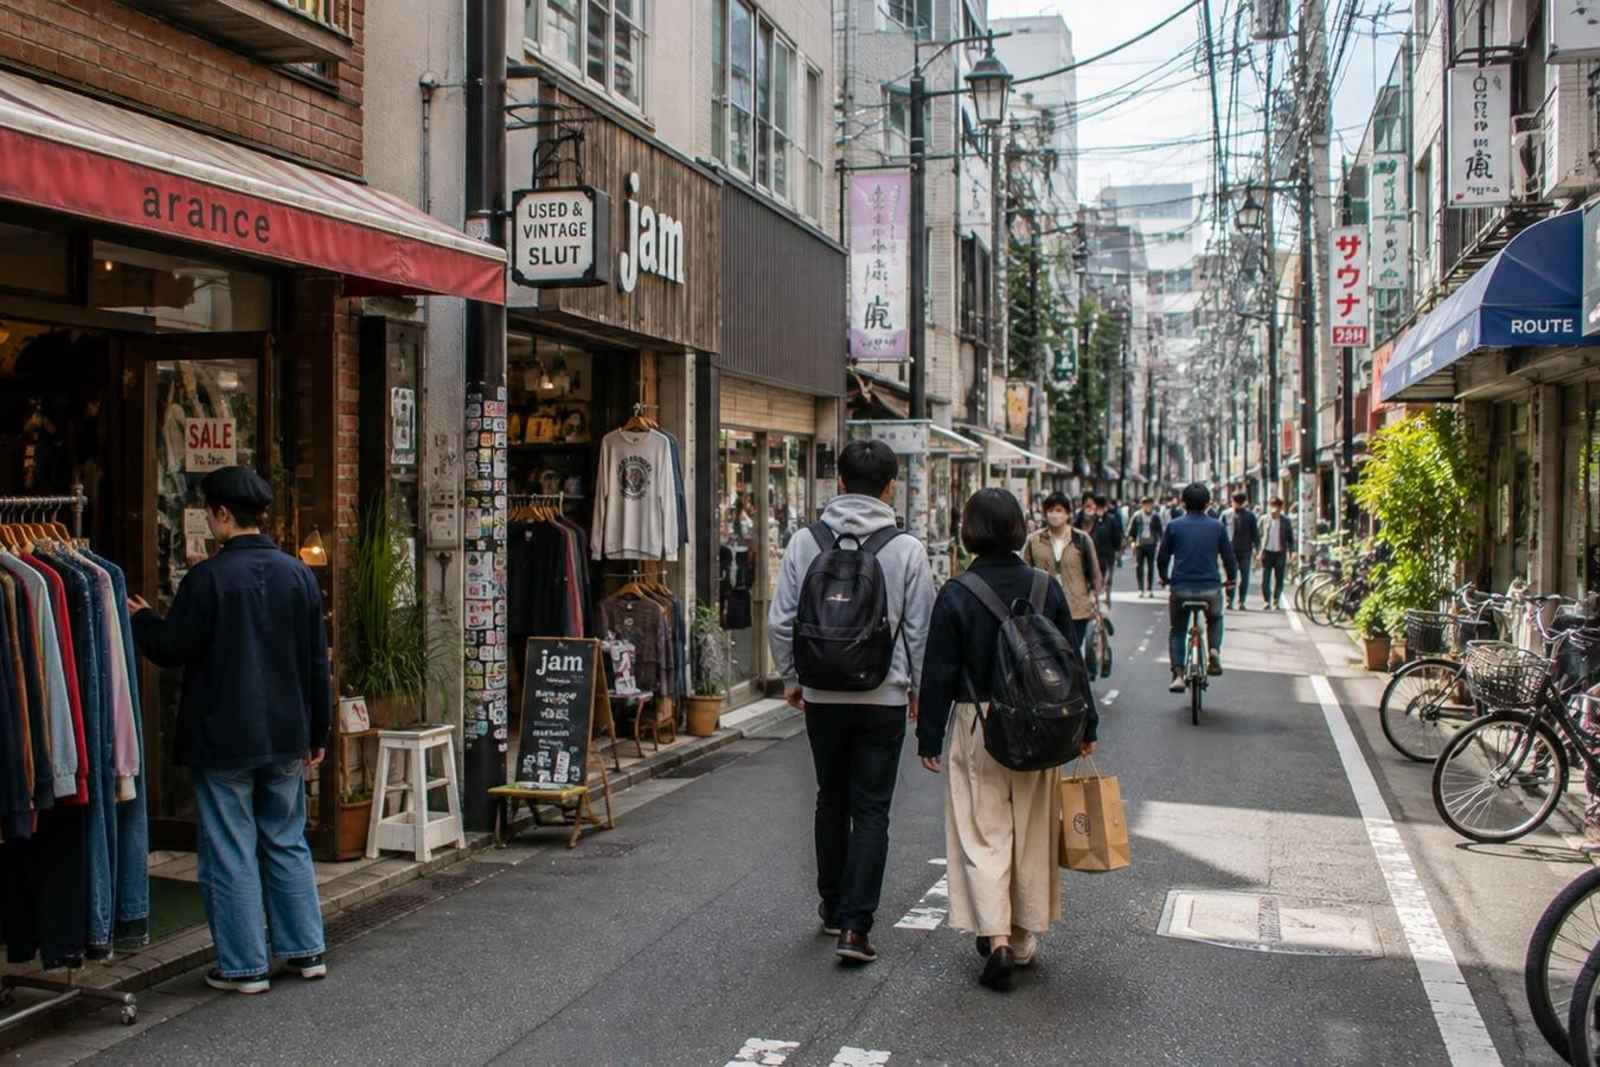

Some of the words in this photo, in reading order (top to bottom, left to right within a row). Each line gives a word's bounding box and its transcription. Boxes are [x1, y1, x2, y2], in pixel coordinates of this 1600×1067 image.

[142, 185, 271, 243] arance
[527, 202, 568, 219] USED
[572, 200, 583, 217] &
[522, 222, 587, 240] VINTAGE
[619, 172, 685, 293] jam
[528, 245, 581, 266] SLUT
[1336, 235, 1361, 317] サウナ
[1511, 319, 1574, 334] ROUTE
[188, 422, 232, 449] SALE
[536, 649, 583, 676] jam
